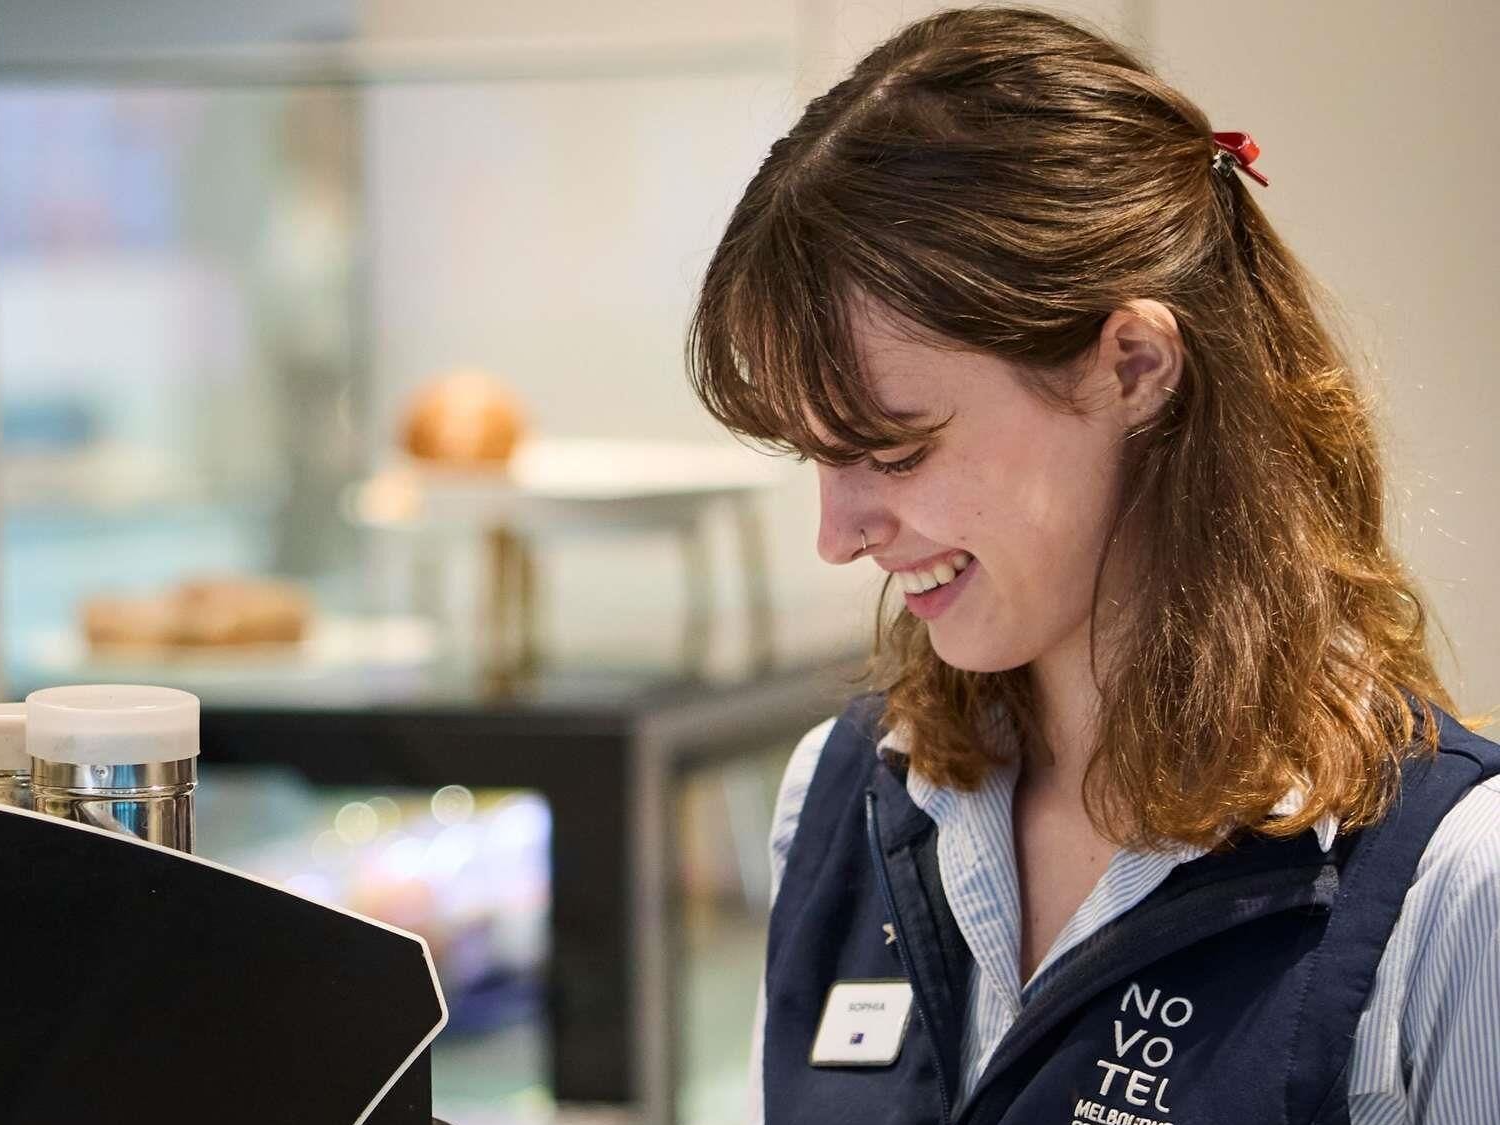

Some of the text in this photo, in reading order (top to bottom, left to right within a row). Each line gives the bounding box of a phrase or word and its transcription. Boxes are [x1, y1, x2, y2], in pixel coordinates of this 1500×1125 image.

[1120, 982, 1193, 1028] NO
[1114, 1020, 1174, 1068] VO
[1097, 1059, 1170, 1113] TEL
